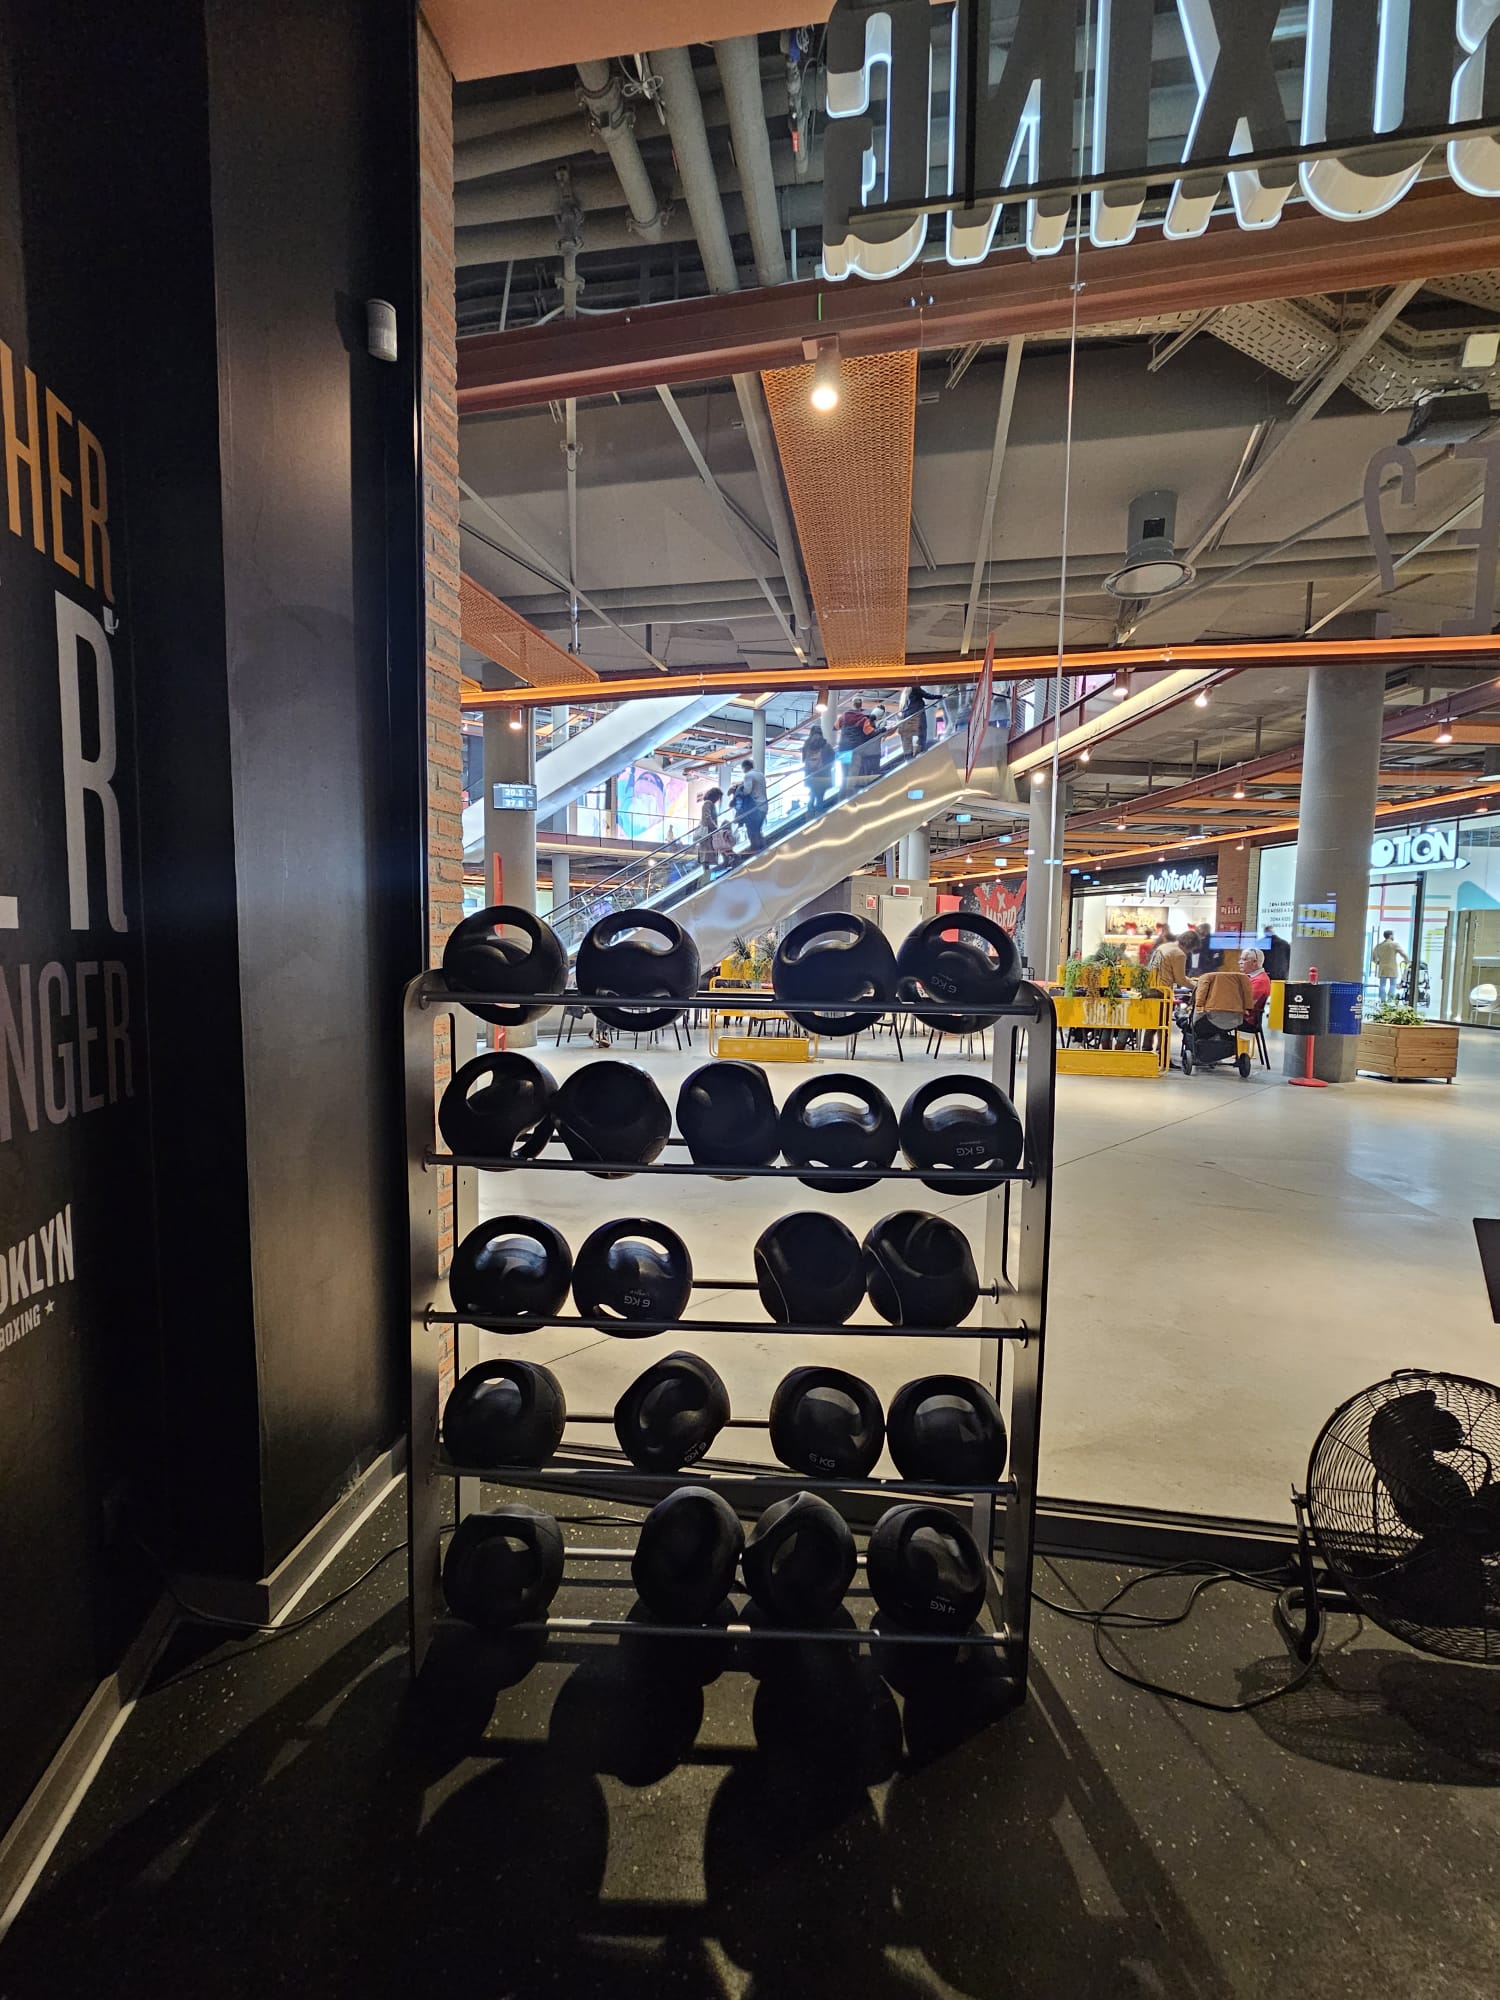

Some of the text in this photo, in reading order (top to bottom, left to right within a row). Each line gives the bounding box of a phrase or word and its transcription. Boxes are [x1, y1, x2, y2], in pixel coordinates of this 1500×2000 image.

[0, 590, 128, 933] R
[956, 1147, 974, 1156] KG
[623, 1295, 641, 1306] KG
[818, 1456, 836, 1468] KG
[930, 1600, 946, 1613] KG
